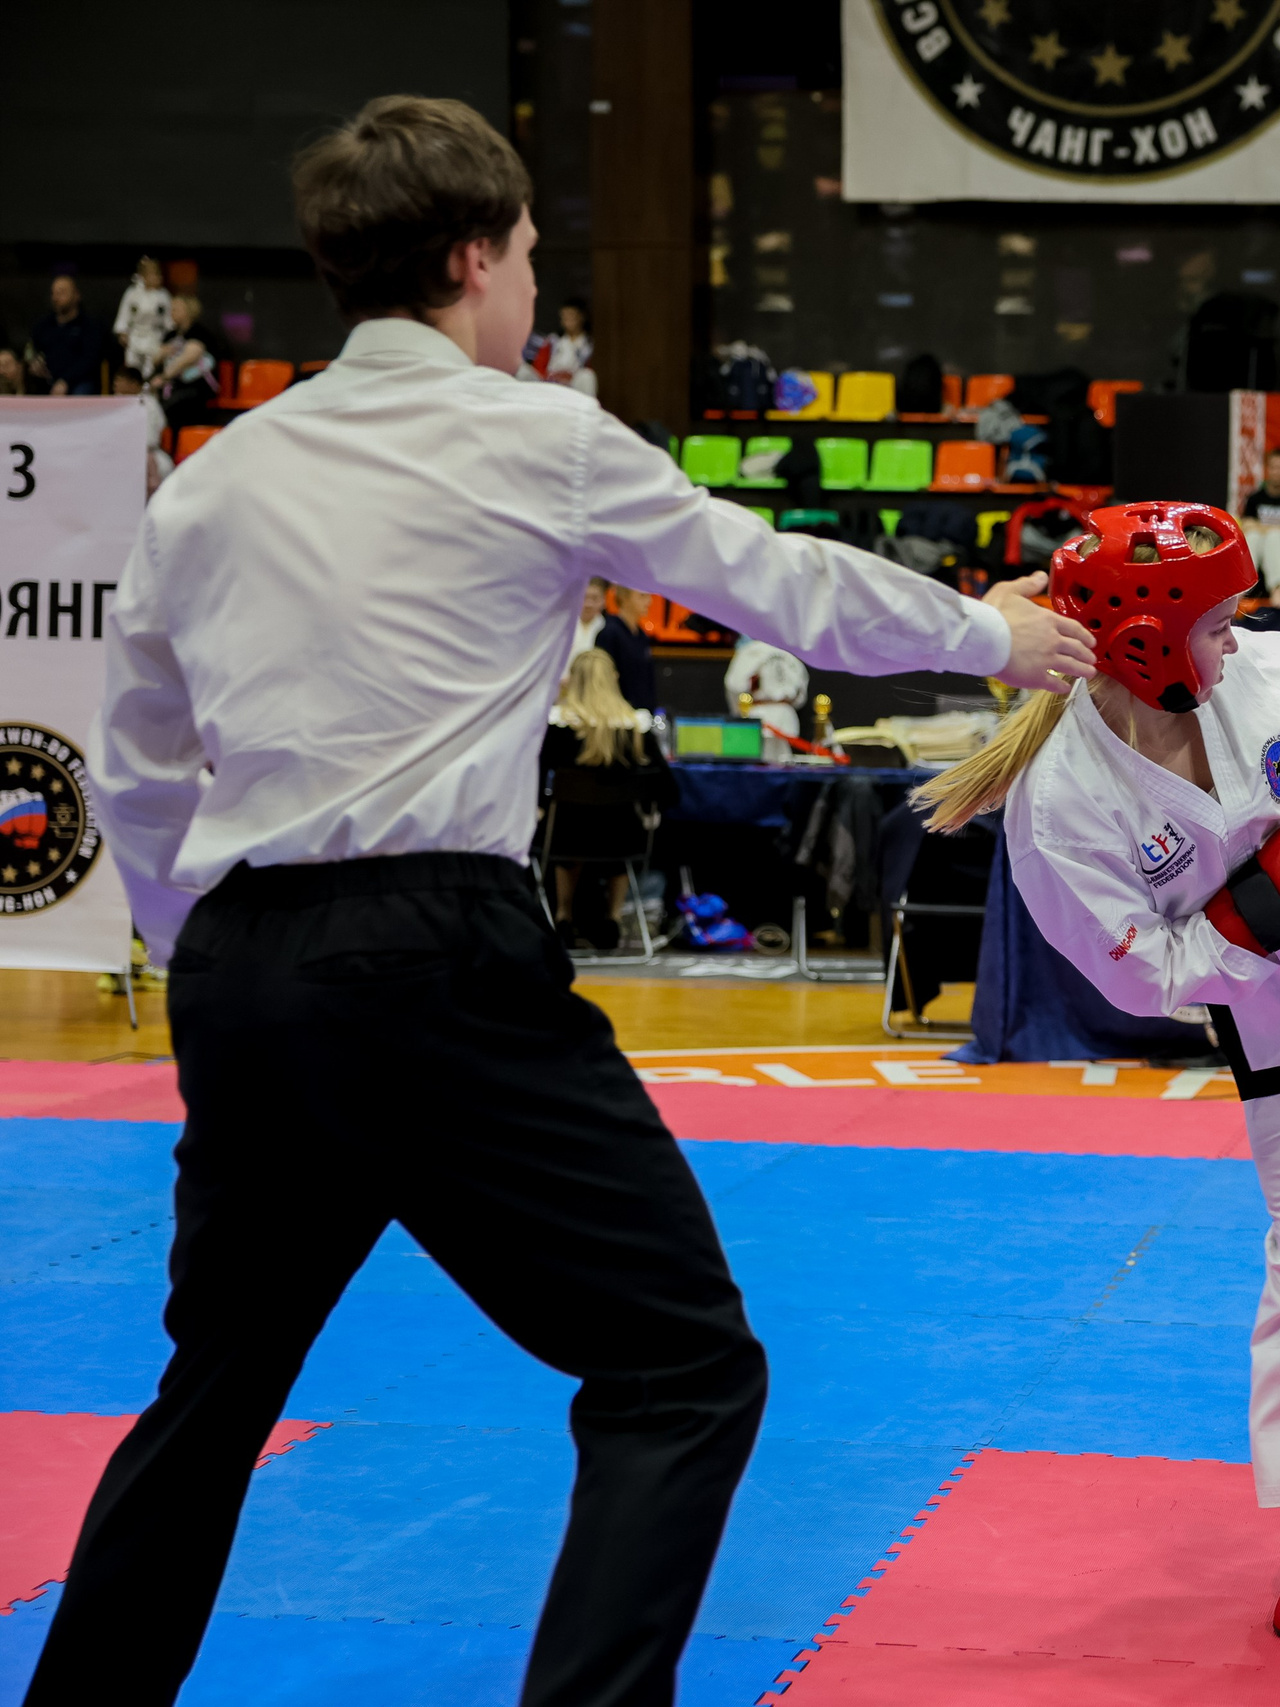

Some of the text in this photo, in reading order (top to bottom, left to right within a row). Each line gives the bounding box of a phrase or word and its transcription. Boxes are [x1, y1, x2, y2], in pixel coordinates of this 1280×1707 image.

[1006, 106, 1219, 166] ЧАНГ-ХОН
[8, 443, 36, 500] 3
[0, 580, 118, 639] ЯНГ
[1153, 857, 1194, 889] FEDERATION
